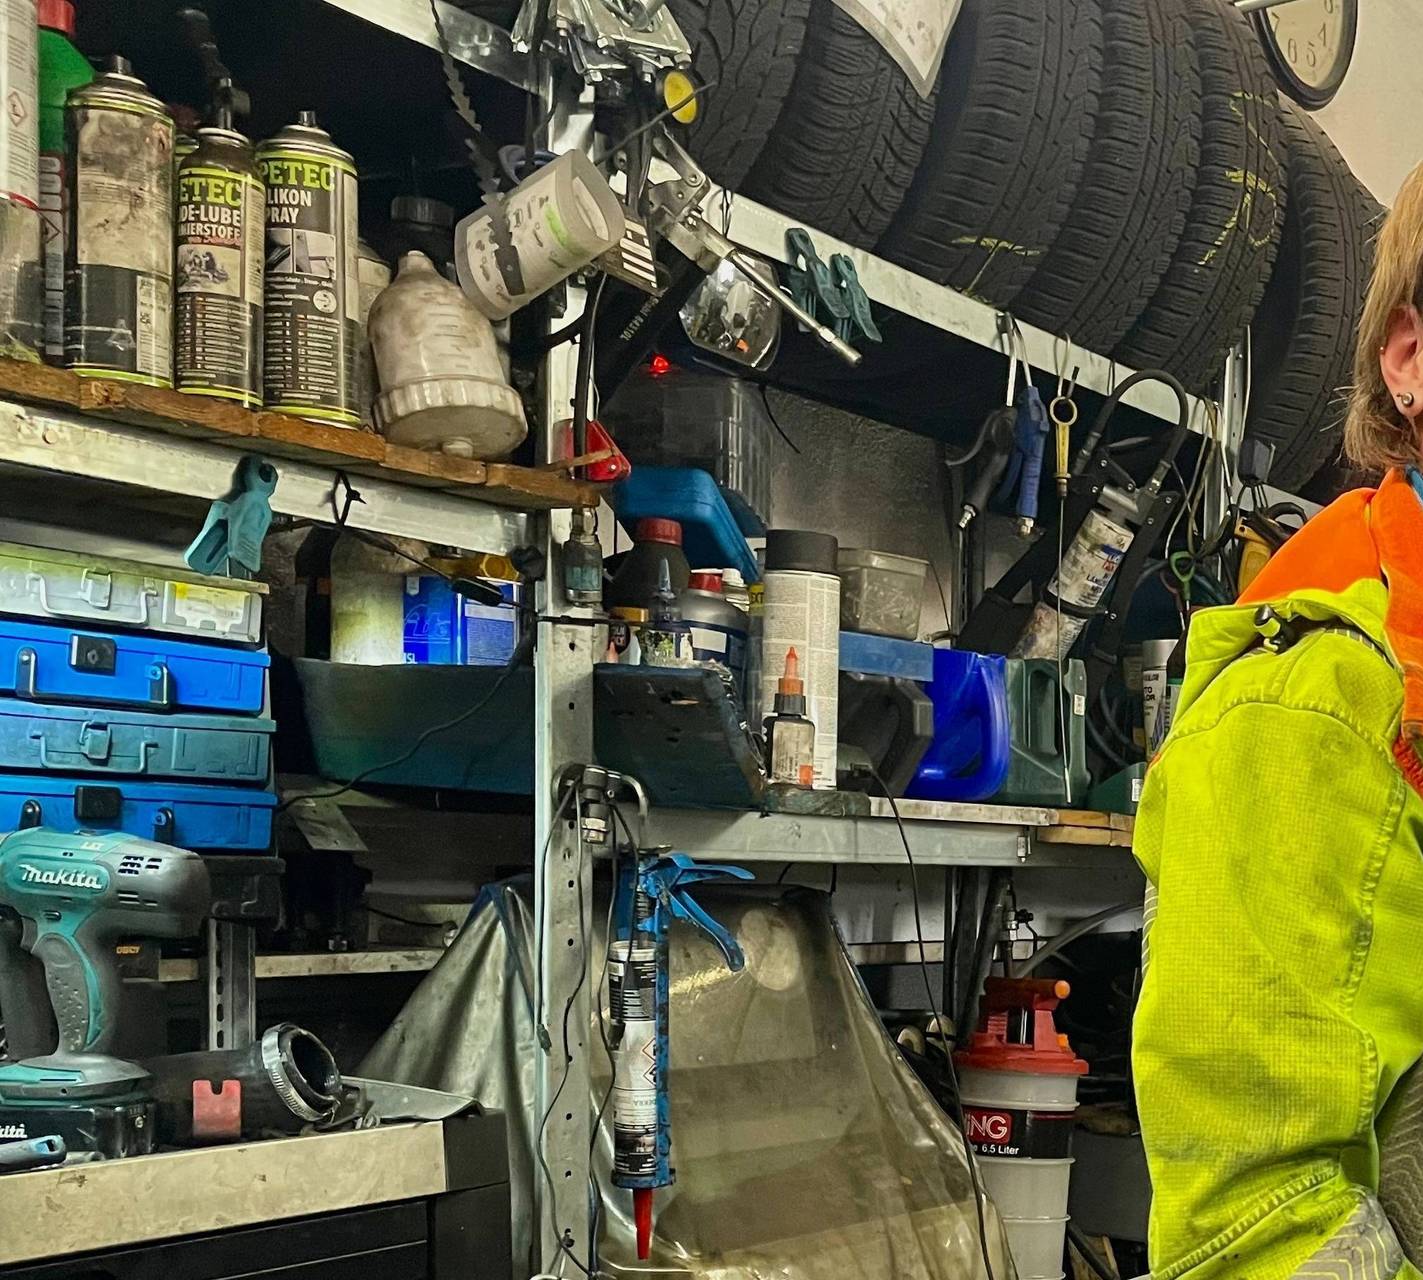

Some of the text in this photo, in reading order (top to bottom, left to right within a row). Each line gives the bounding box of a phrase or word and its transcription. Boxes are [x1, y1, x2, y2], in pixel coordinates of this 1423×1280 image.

[179, 177, 242, 207] ETEC
[267, 188, 312, 207] LIKON
[179, 204, 242, 227] DE-LUBE
[965, 1113, 1008, 1140] ING
[998, 1145, 1020, 1155] Liter
